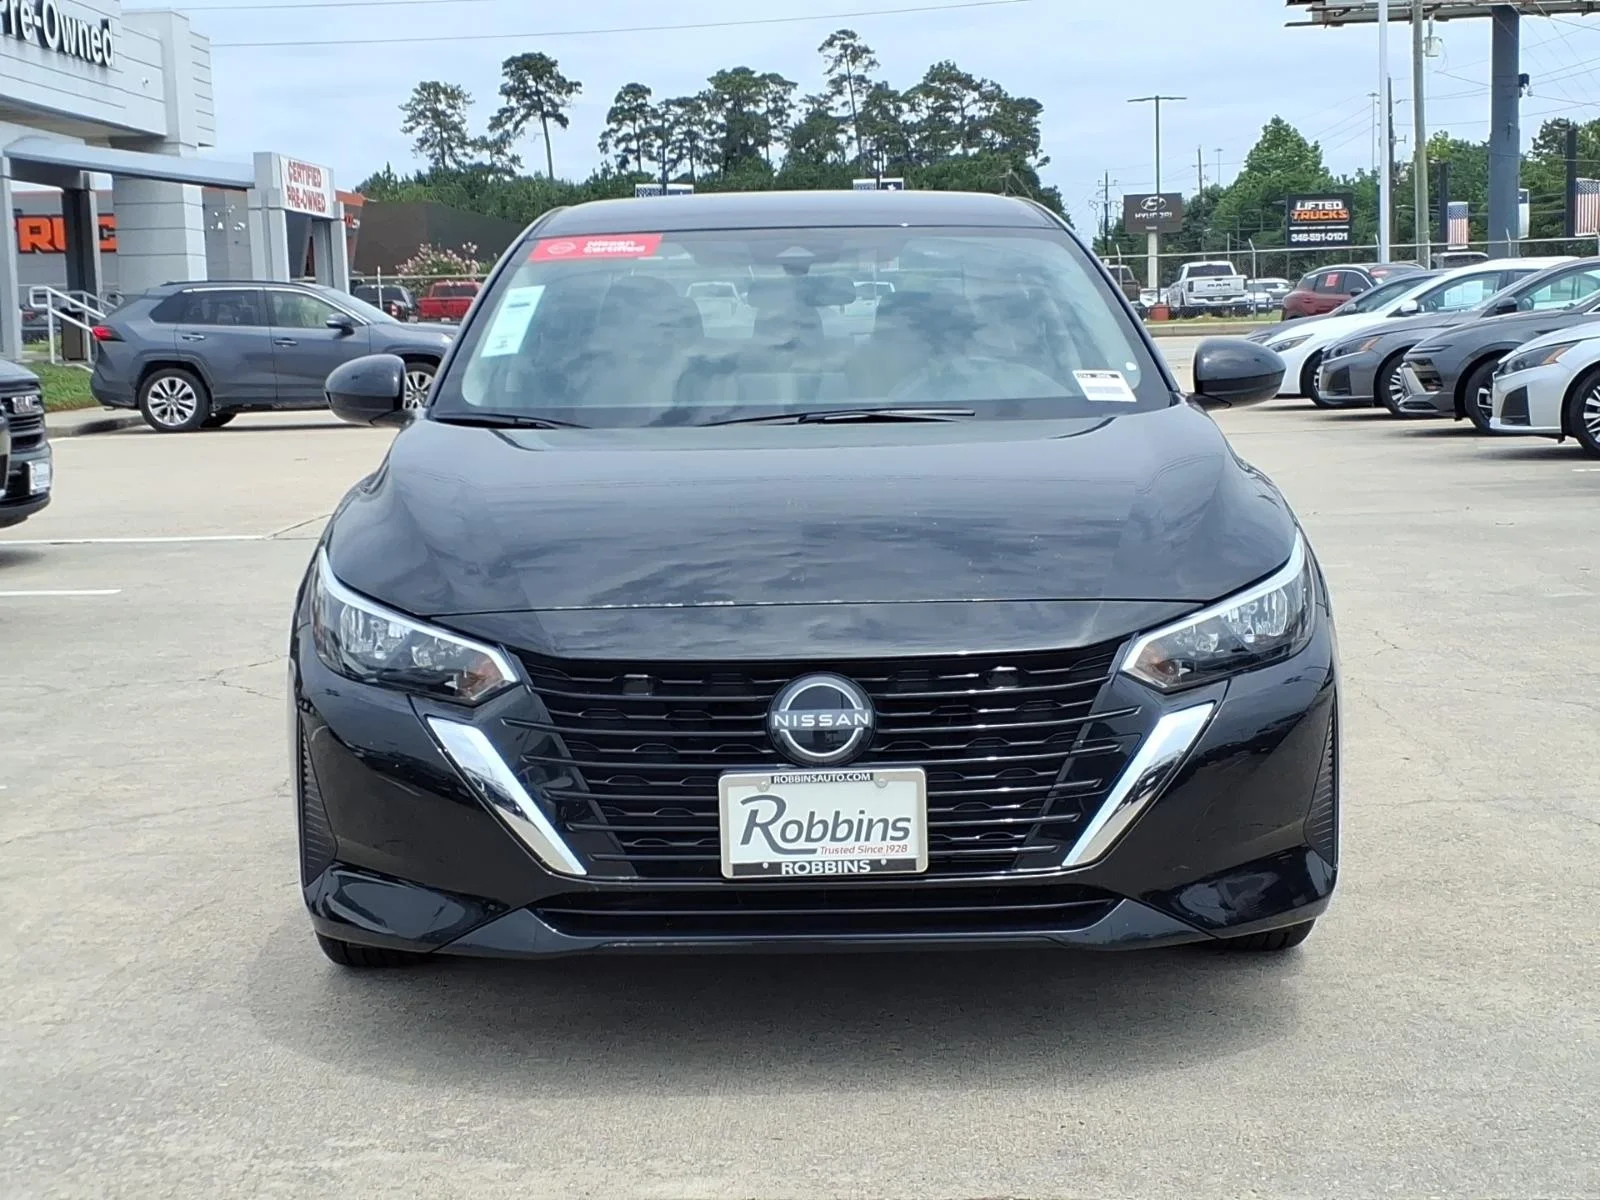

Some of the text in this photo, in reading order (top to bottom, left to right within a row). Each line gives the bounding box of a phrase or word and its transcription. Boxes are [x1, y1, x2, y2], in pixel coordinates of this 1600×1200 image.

[288, 160, 322, 188] CERTIFIED
[286, 185, 326, 213] PRE-OWNED
[1296, 201, 1343, 210] LIFTED
[1293, 209, 1349, 221] TRUCKS
[774, 712, 869, 727] NISSAN
[773, 773, 871, 784] ROBBINSAUTO.COM
[740, 795, 911, 855] Robbins
[821, 844, 908, 855] Trusted Since 1928
[781, 860, 871, 875] ROBBINS
